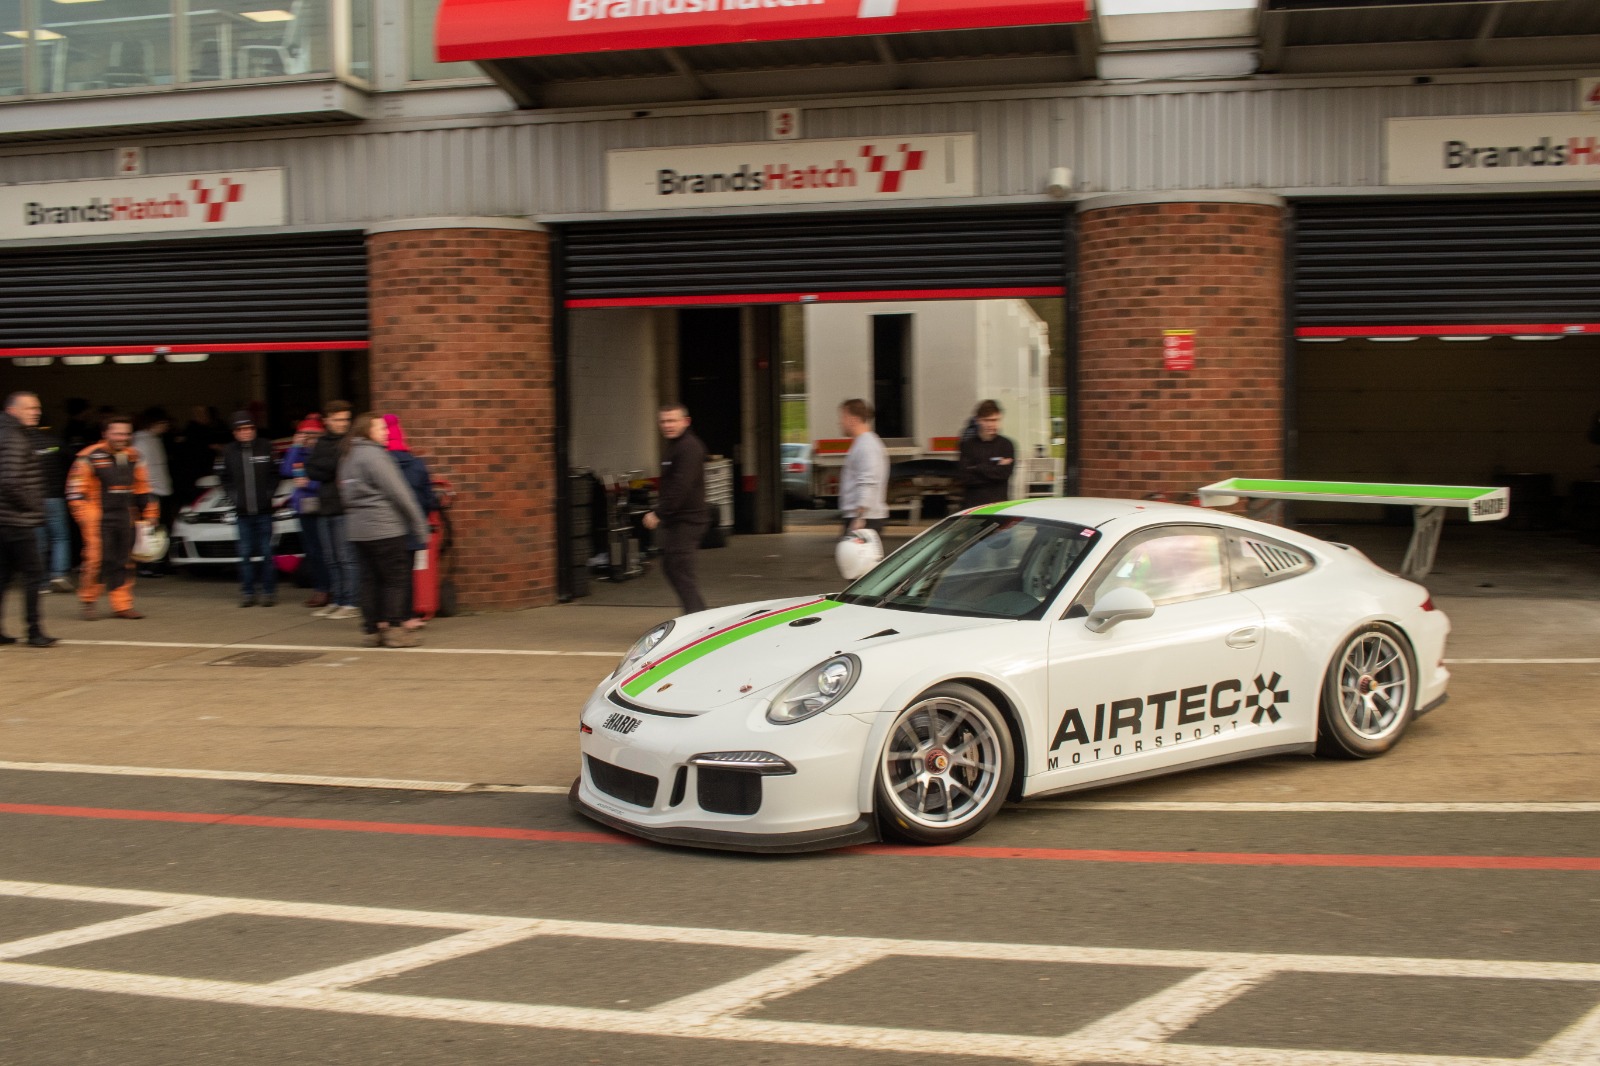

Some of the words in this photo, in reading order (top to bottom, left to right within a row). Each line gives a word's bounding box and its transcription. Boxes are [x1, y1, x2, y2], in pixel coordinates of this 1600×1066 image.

[775, 112, 795, 135] 3
[121, 150, 137, 172] 2
[656, 159, 857, 195] BrandsHatch
[24, 192, 189, 225] BrandsHatch
[606, 712, 638, 735] HARD
[1049, 678, 1242, 752] AIRTEC
[1047, 720, 1239, 771] MOTORSPORT
